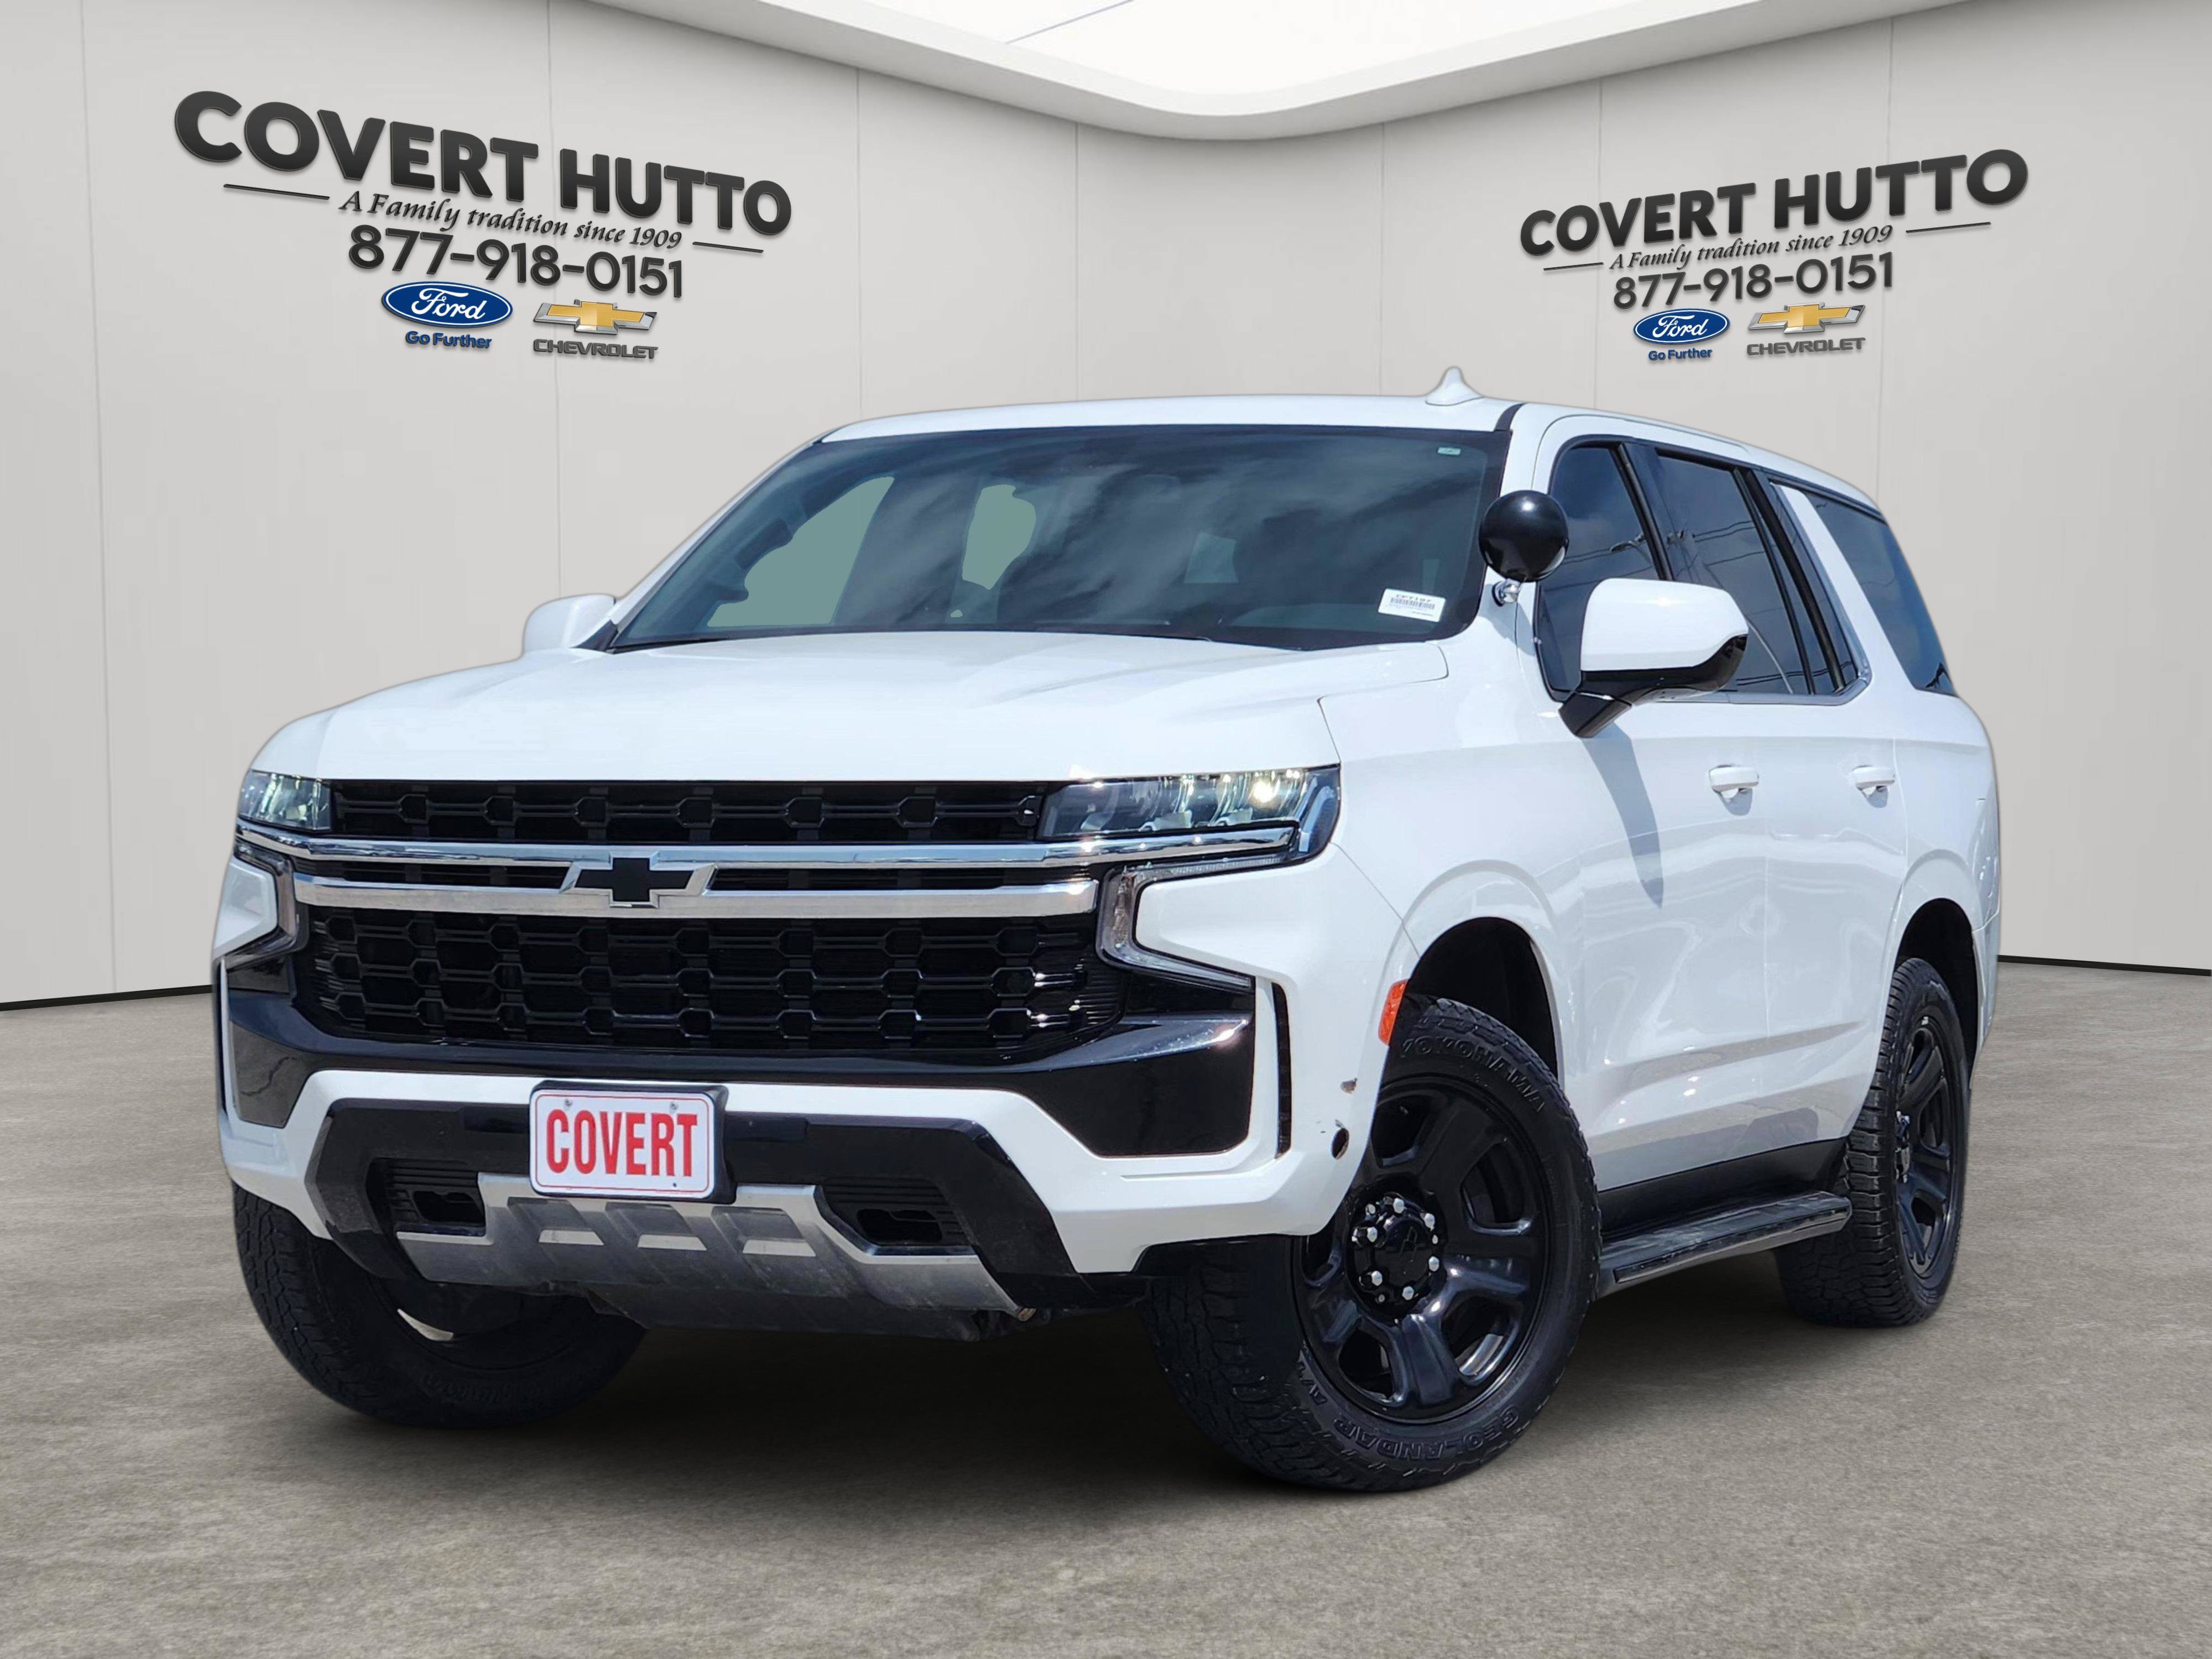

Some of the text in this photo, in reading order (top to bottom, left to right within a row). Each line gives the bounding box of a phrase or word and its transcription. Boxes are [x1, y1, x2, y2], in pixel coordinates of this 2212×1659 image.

[175, 91, 791, 236] COVERT HUTTO
[338, 191, 682, 249] A Family tradition since 1909
[1521, 149, 2028, 256] COVERT HUTTO
[349, 225, 682, 298] 877-918-0151
[1609, 225, 1893, 270] A Family tradition since 1909
[411, 288, 488, 321] Ford
[1614, 252, 1892, 310] 877-918-0151
[405, 331, 492, 349] Go Further
[534, 338, 658, 359] CHEVROLET
[1648, 348, 1712, 361] Go Further
[1652, 315, 1708, 339] Ford
[1747, 338, 1865, 356] CHEVROLET
[1401, 1035, 1546, 1113] YOKOHAMA
[546, 1109, 697, 1177] COVERT
[1333, 1405, 1519, 1460] GEOLANDAR
